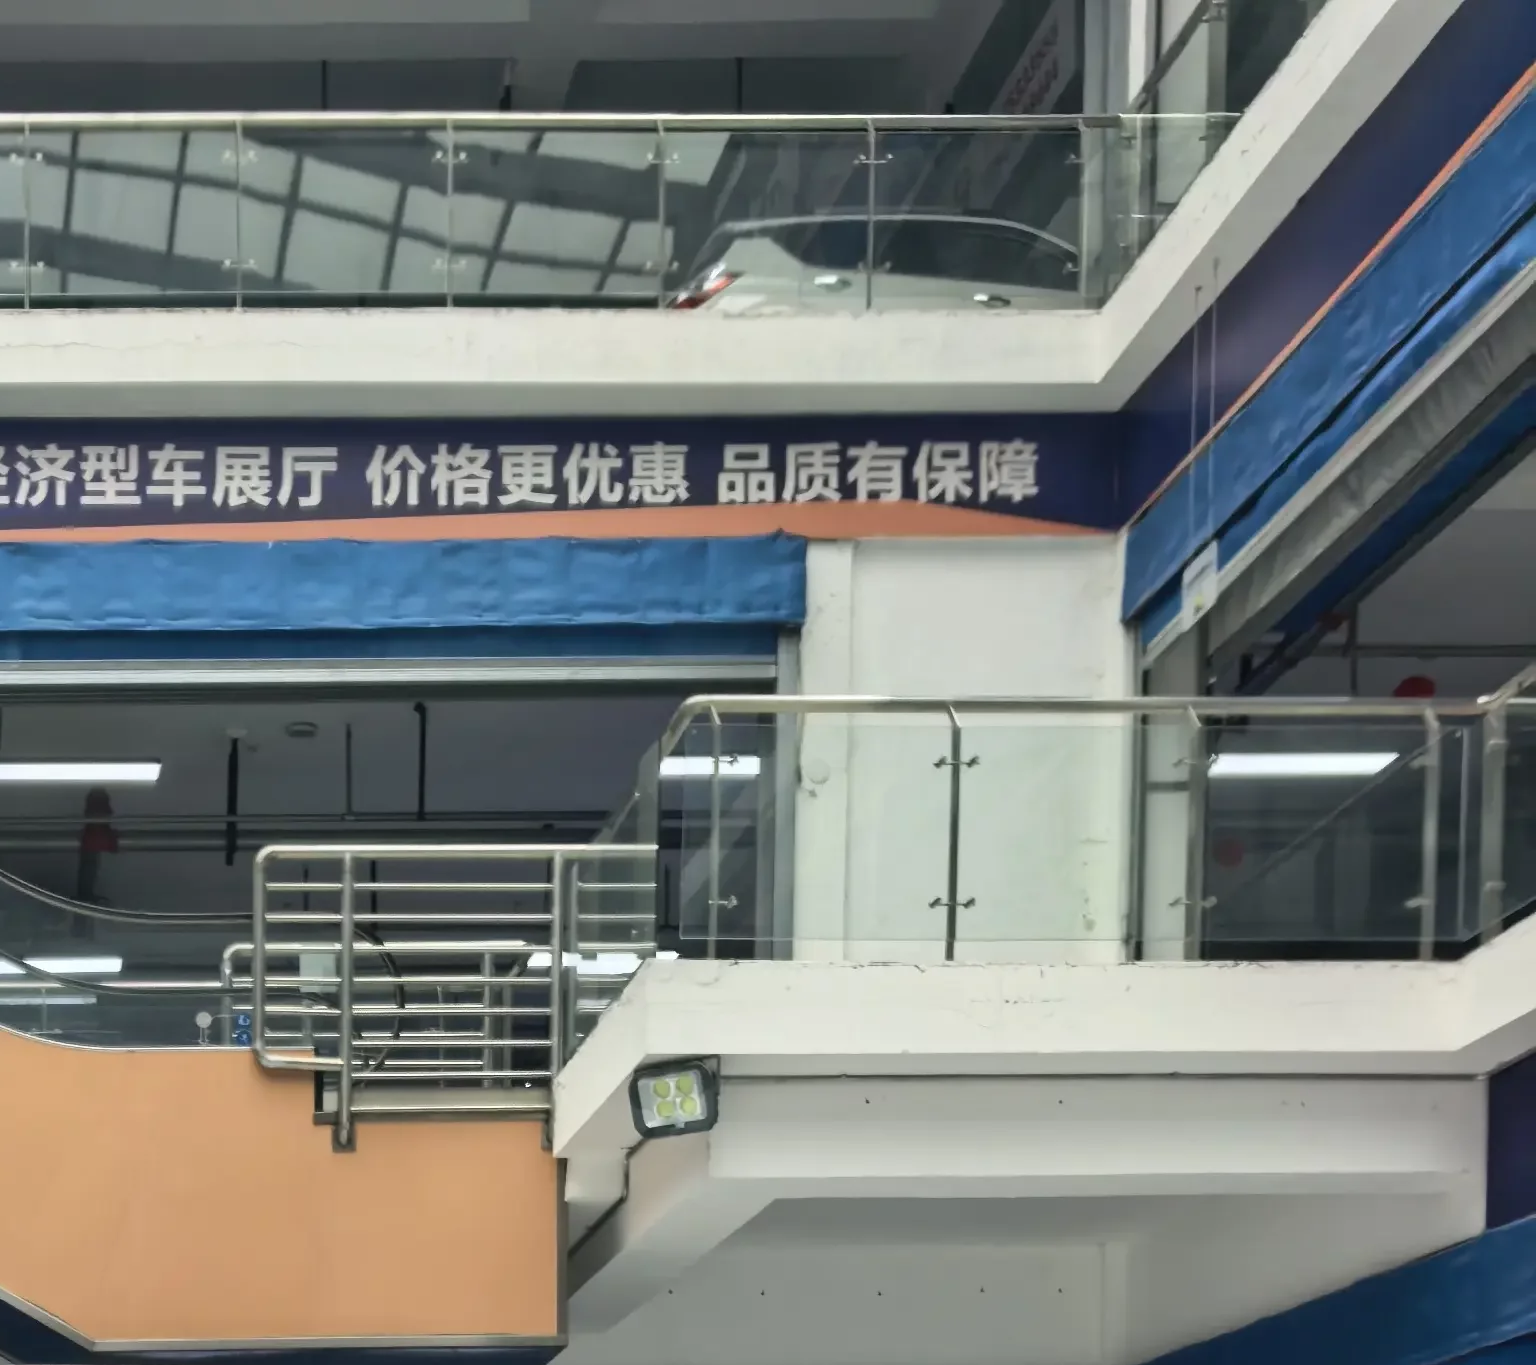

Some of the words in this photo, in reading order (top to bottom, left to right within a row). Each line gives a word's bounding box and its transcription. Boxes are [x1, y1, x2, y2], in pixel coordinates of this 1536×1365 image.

[364, 442, 690, 506] 价格更优惠
[717, 437, 1039, 504] 品质有保障
